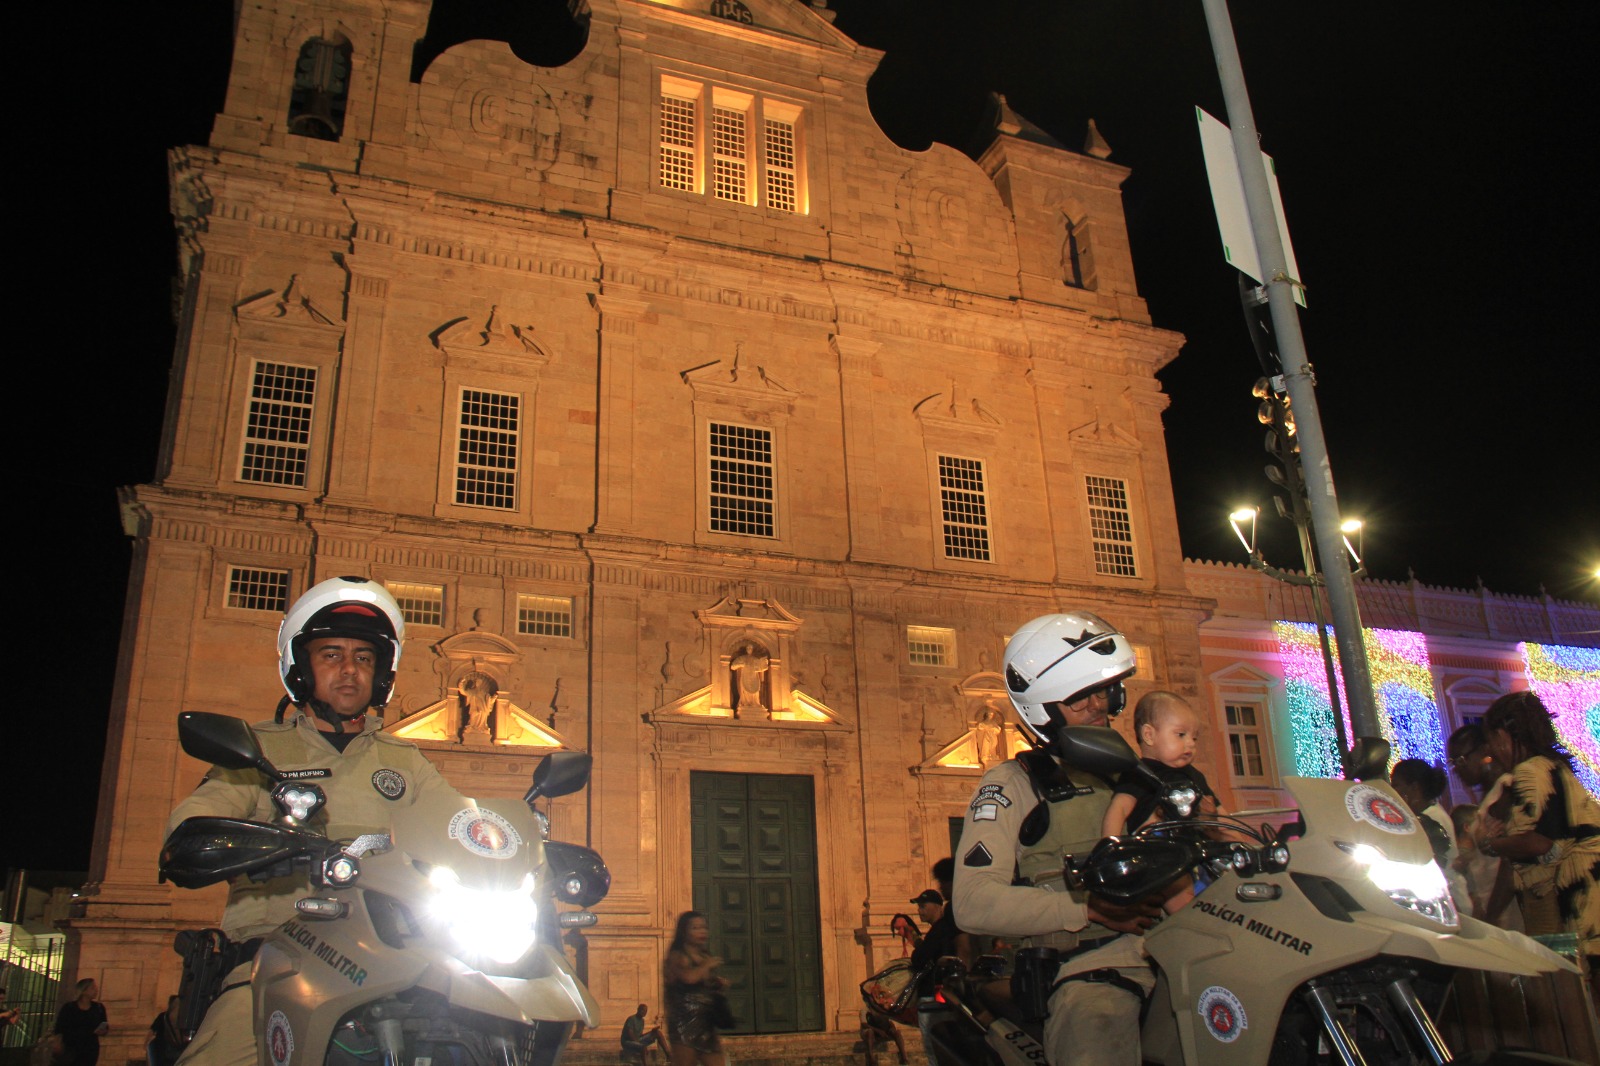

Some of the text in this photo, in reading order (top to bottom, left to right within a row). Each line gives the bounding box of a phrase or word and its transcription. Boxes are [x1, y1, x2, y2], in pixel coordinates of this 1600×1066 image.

[462, 808, 493, 816] MILTAR
[1192, 900, 1313, 956] POLÍCIA MILITAR
[314, 941, 368, 987] MILITAR
